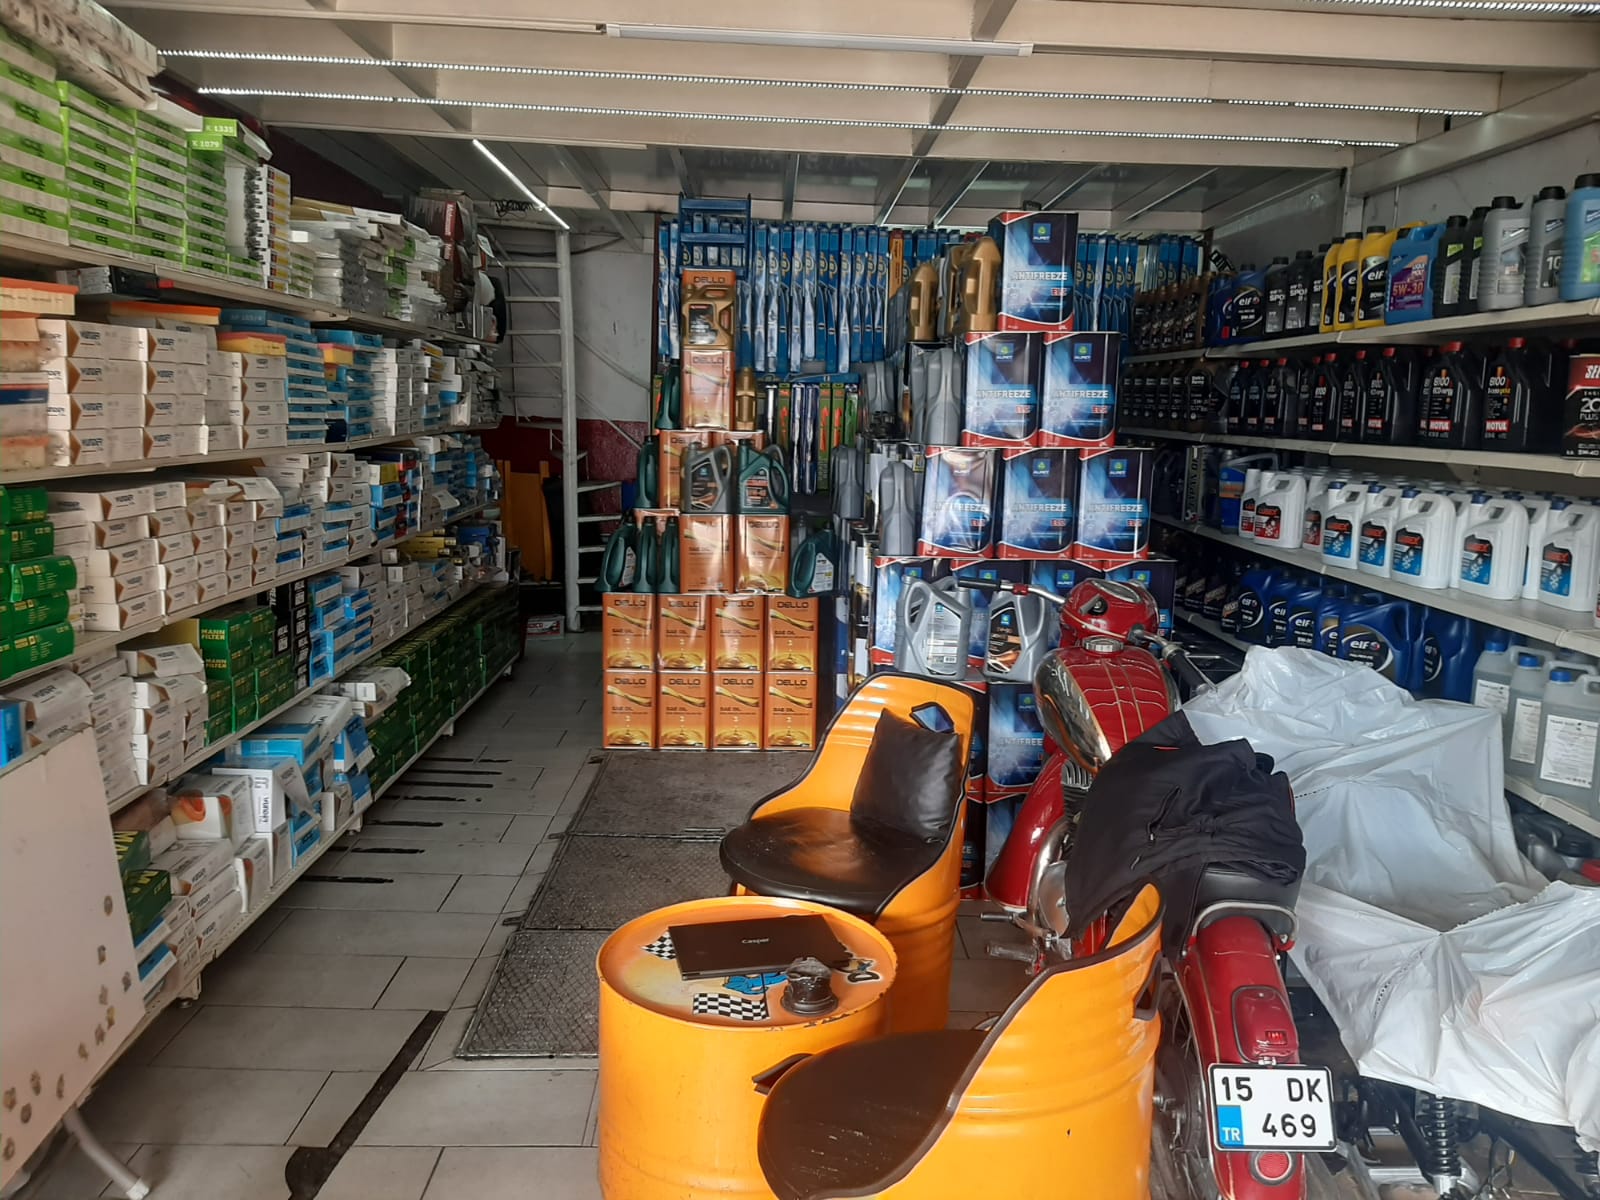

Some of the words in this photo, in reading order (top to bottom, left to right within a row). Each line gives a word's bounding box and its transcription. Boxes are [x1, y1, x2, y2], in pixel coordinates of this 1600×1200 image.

[693, 276, 726, 284] DELLO
[1011, 271, 1068, 281] ANTIFREEZE
[1368, 270, 1385, 281] elf
[1392, 282, 1424, 297] 5W-30
[1239, 297, 1253, 306] elf
[692, 356, 725, 365] DELLO
[975, 389, 1032, 399] ANTIFREEZE
[1053, 389, 1110, 399] ANTIFREEZE
[1429, 420, 1451, 431] MOTUL
[1485, 420, 1508, 431] MOTUL
[1010, 503, 1068, 513] ANTIFREEZE
[1087, 503, 1144, 513] ANTIFREEZE
[614, 599, 647, 607] DELLO
[777, 601, 809, 609] DELLO
[1295, 618, 1311, 627] elf
[1350, 640, 1370, 650] elf
[669, 678, 701, 686] DELLO
[722, 678, 754, 686] DELLO
[999, 737, 1043, 746] ANTIFREE
[741, 937, 769, 945] Casper
[1221, 1076, 1253, 1101] 15
[1286, 1078, 1323, 1102] DK
[1262, 1113, 1317, 1138] 469
[1222, 1127, 1241, 1142] TR
